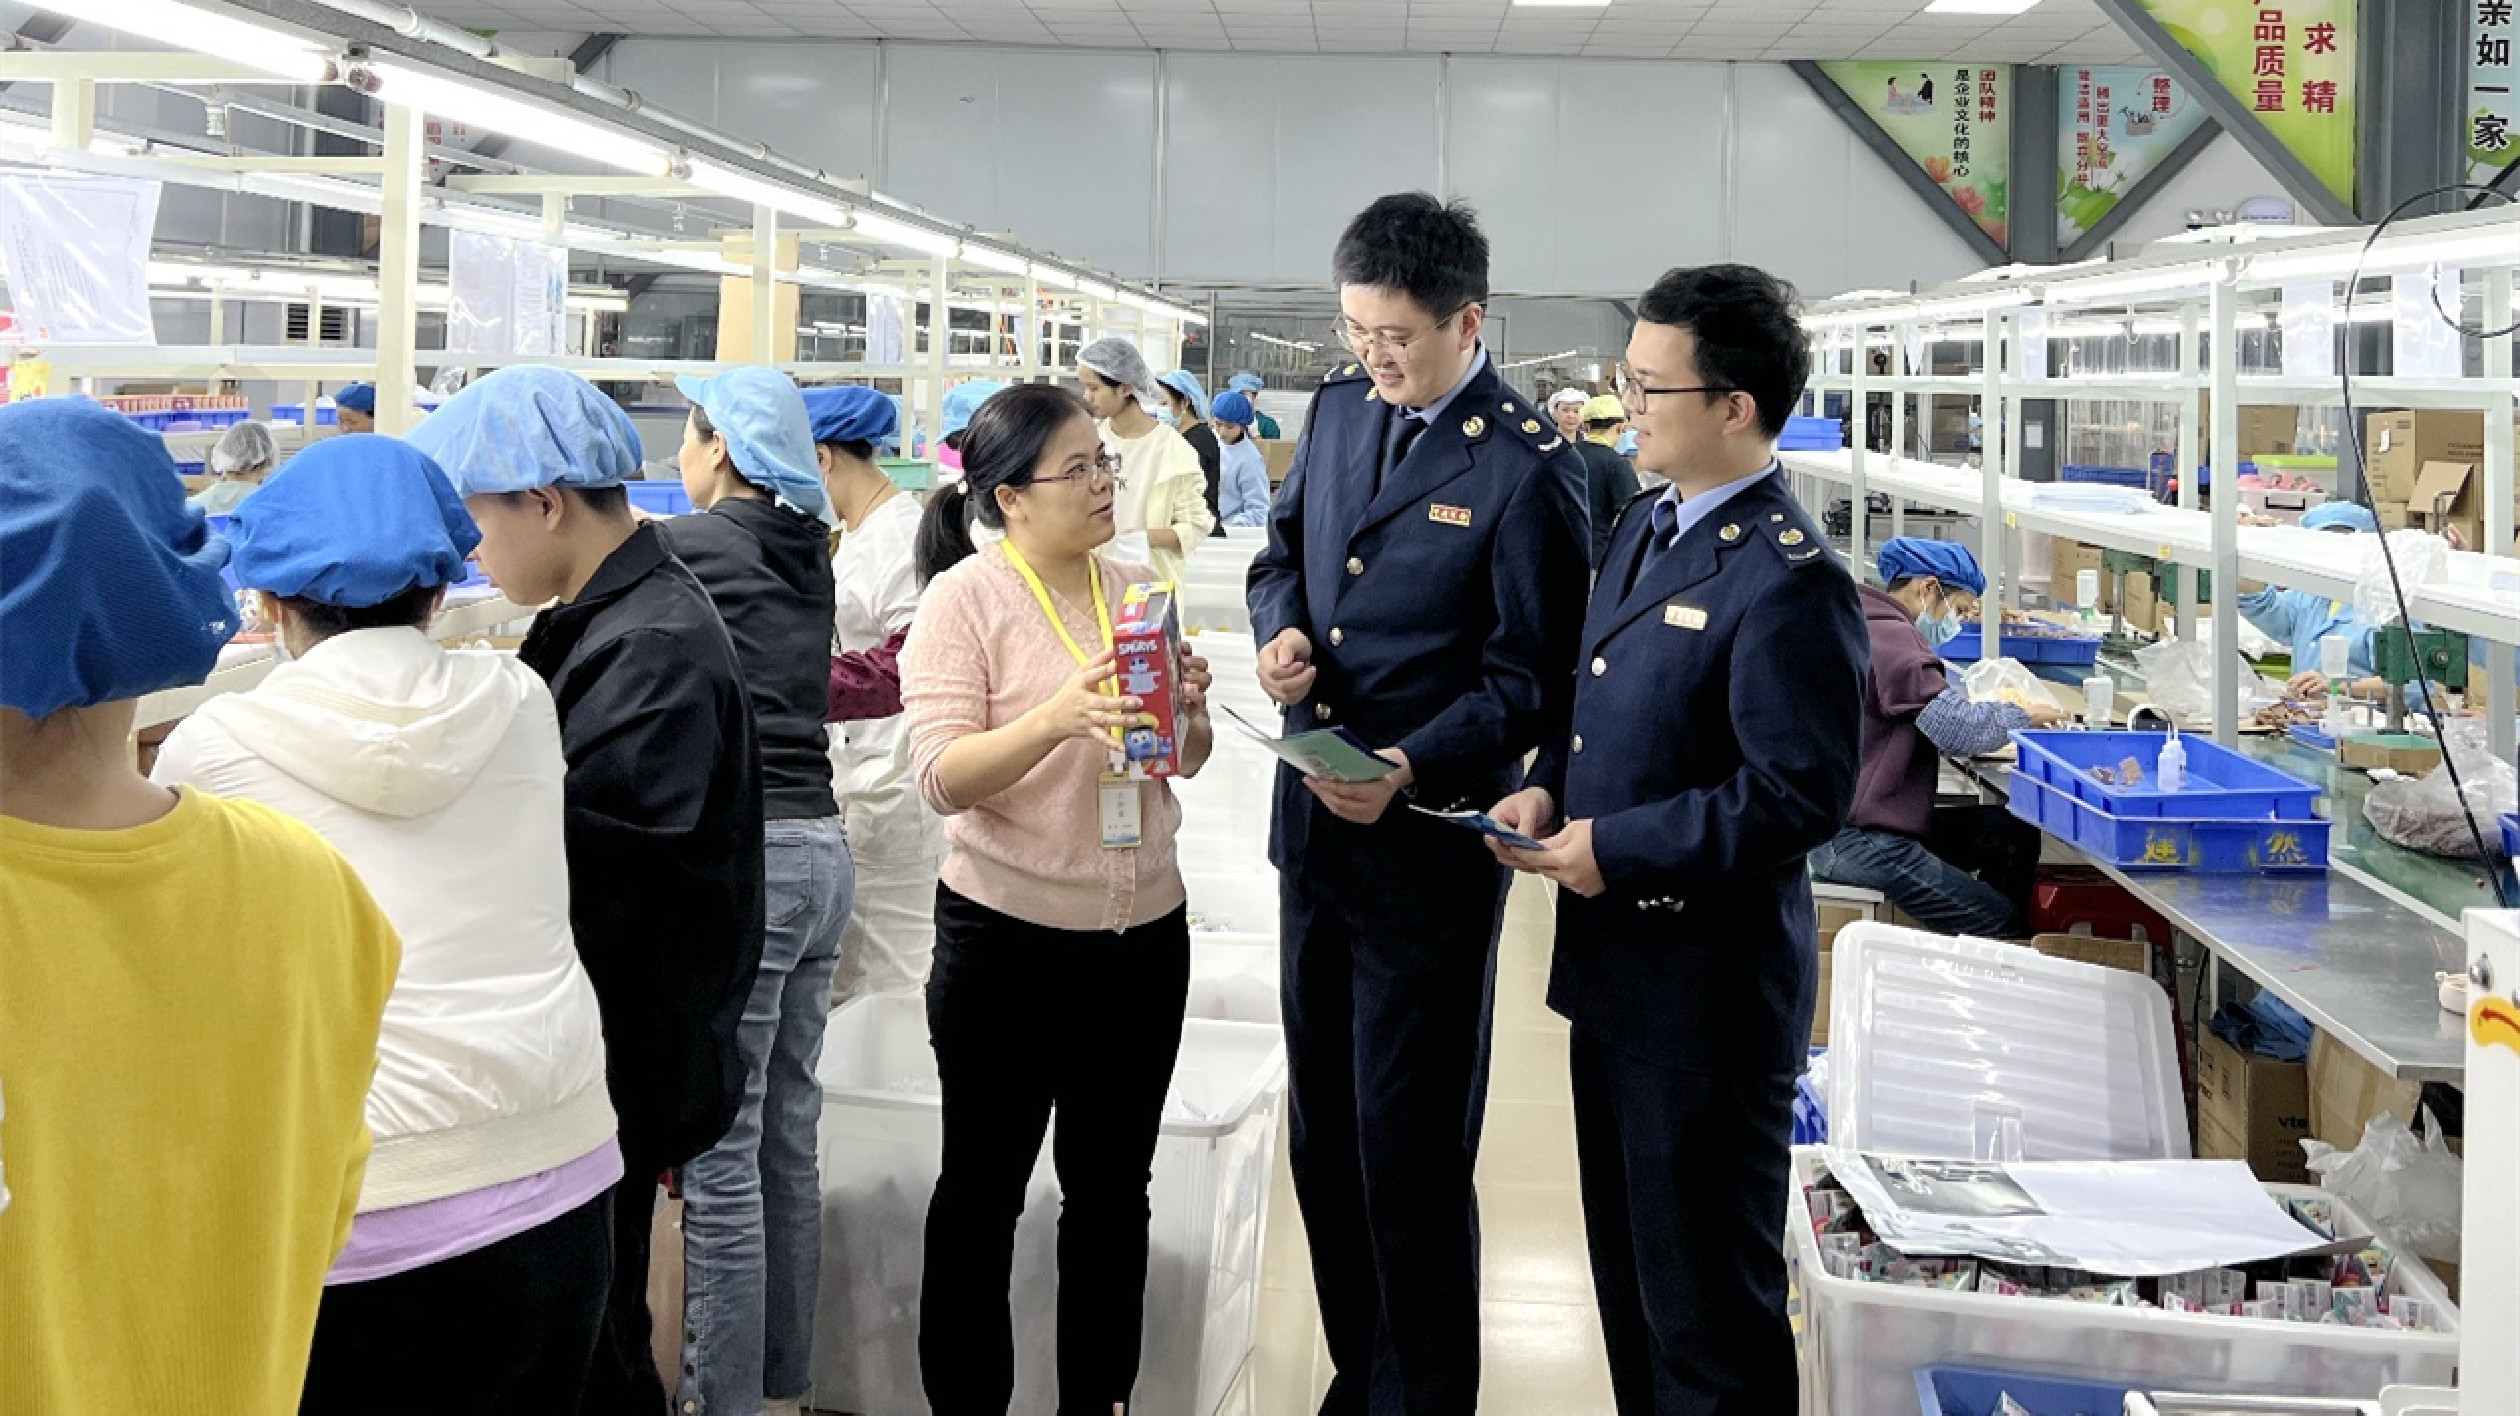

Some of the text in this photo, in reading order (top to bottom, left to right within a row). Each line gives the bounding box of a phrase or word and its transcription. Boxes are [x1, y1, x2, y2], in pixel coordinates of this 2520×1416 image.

[1979, 68, 1996, 123] 团队精神
[2151, 78, 2171, 113] 整理
[2252, 0, 2285, 112] 品质量
[1953, 68, 1970, 178] 是企业文化的核心
